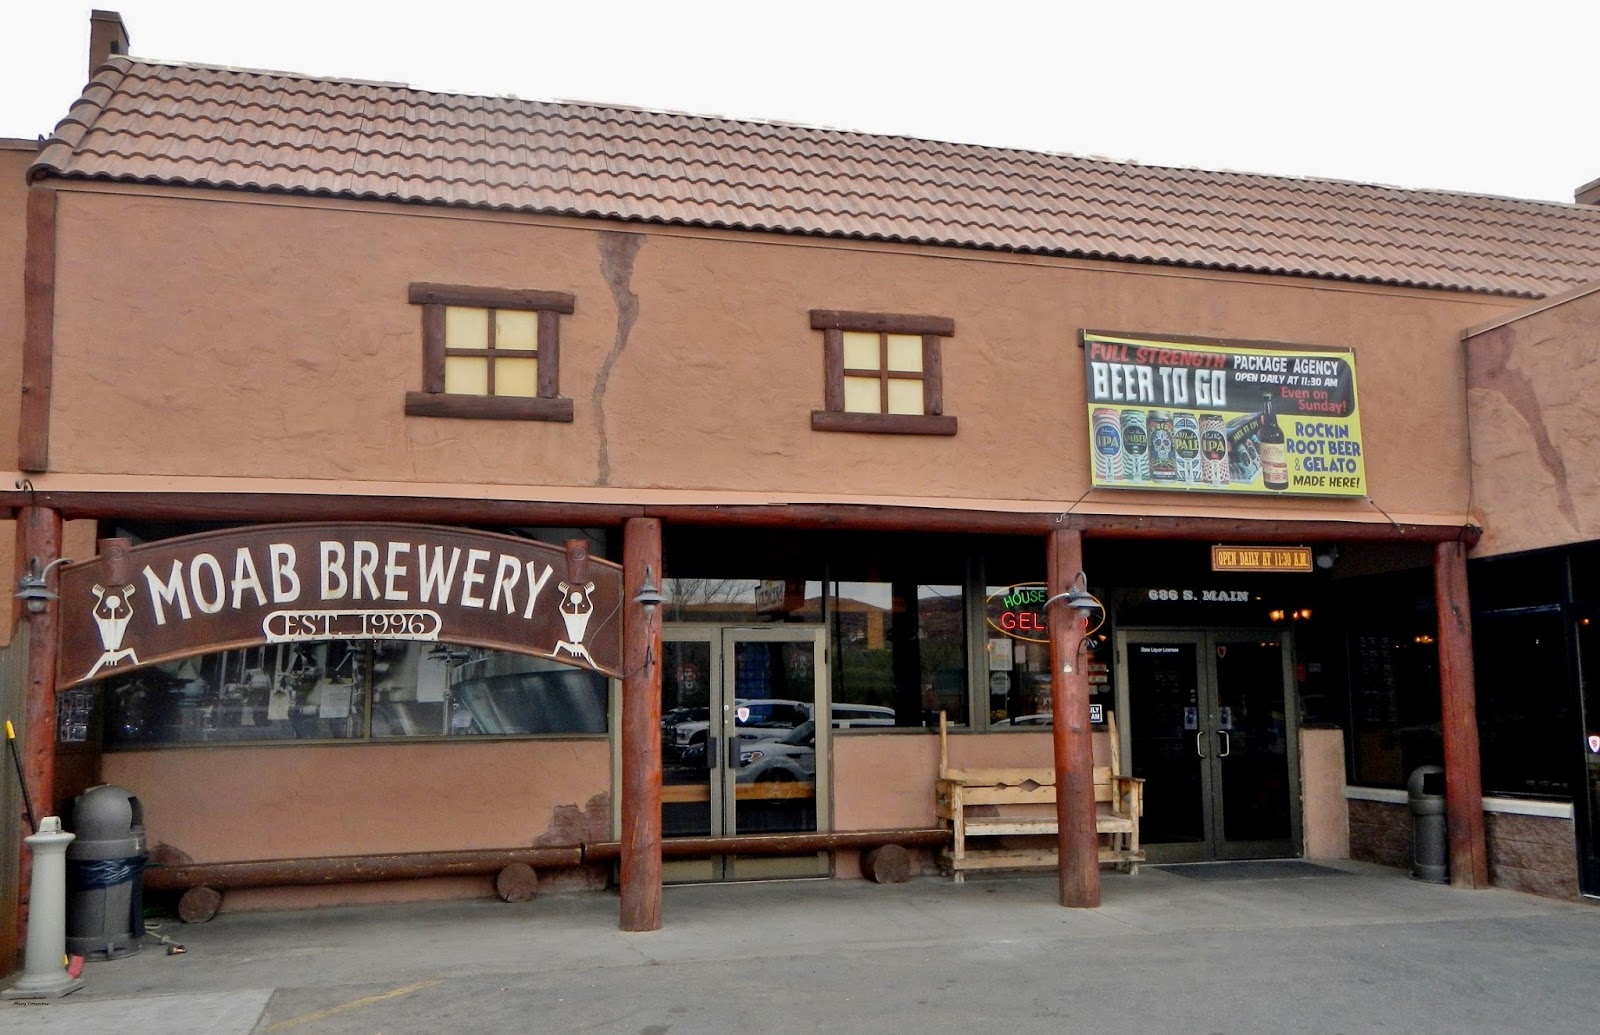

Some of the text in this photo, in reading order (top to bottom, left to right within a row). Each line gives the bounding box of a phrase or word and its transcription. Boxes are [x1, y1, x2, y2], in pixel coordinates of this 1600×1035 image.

[1090, 343, 1227, 368] FULL STRENGTH
[1233, 355, 1339, 376] PACKAGE AGENCY
[1091, 361, 1227, 407] BEER TO GO
[1234, 372, 1339, 388] OPEN DAILY AT 11:30 AM
[1281, 387, 1329, 400] Even on
[1298, 399, 1347, 414] Sunday!
[1295, 421, 1349, 439] ROCKIN
[1175, 438, 1199, 451] PALE
[1201, 439, 1225, 452] IPA
[1286, 438, 1326, 455] ROOT
[1328, 440, 1361, 457] BEER
[1294, 456, 1357, 474] & GELATO
[1293, 475, 1326, 487] MADE
[1329, 476, 1360, 488] HERE!
[1218, 551, 1237, 566] OPEN
[1240, 551, 1260, 566] DAILY
[1262, 551, 1272, 566] AT
[1274, 552, 1291, 567] 11:30
[142, 540, 554, 625] MOAB BREWERY
[1003, 590, 1046, 609] HOUSE
[1148, 589, 1249, 602] 686 S. MAIN
[284, 612, 427, 636] EST. 1996
